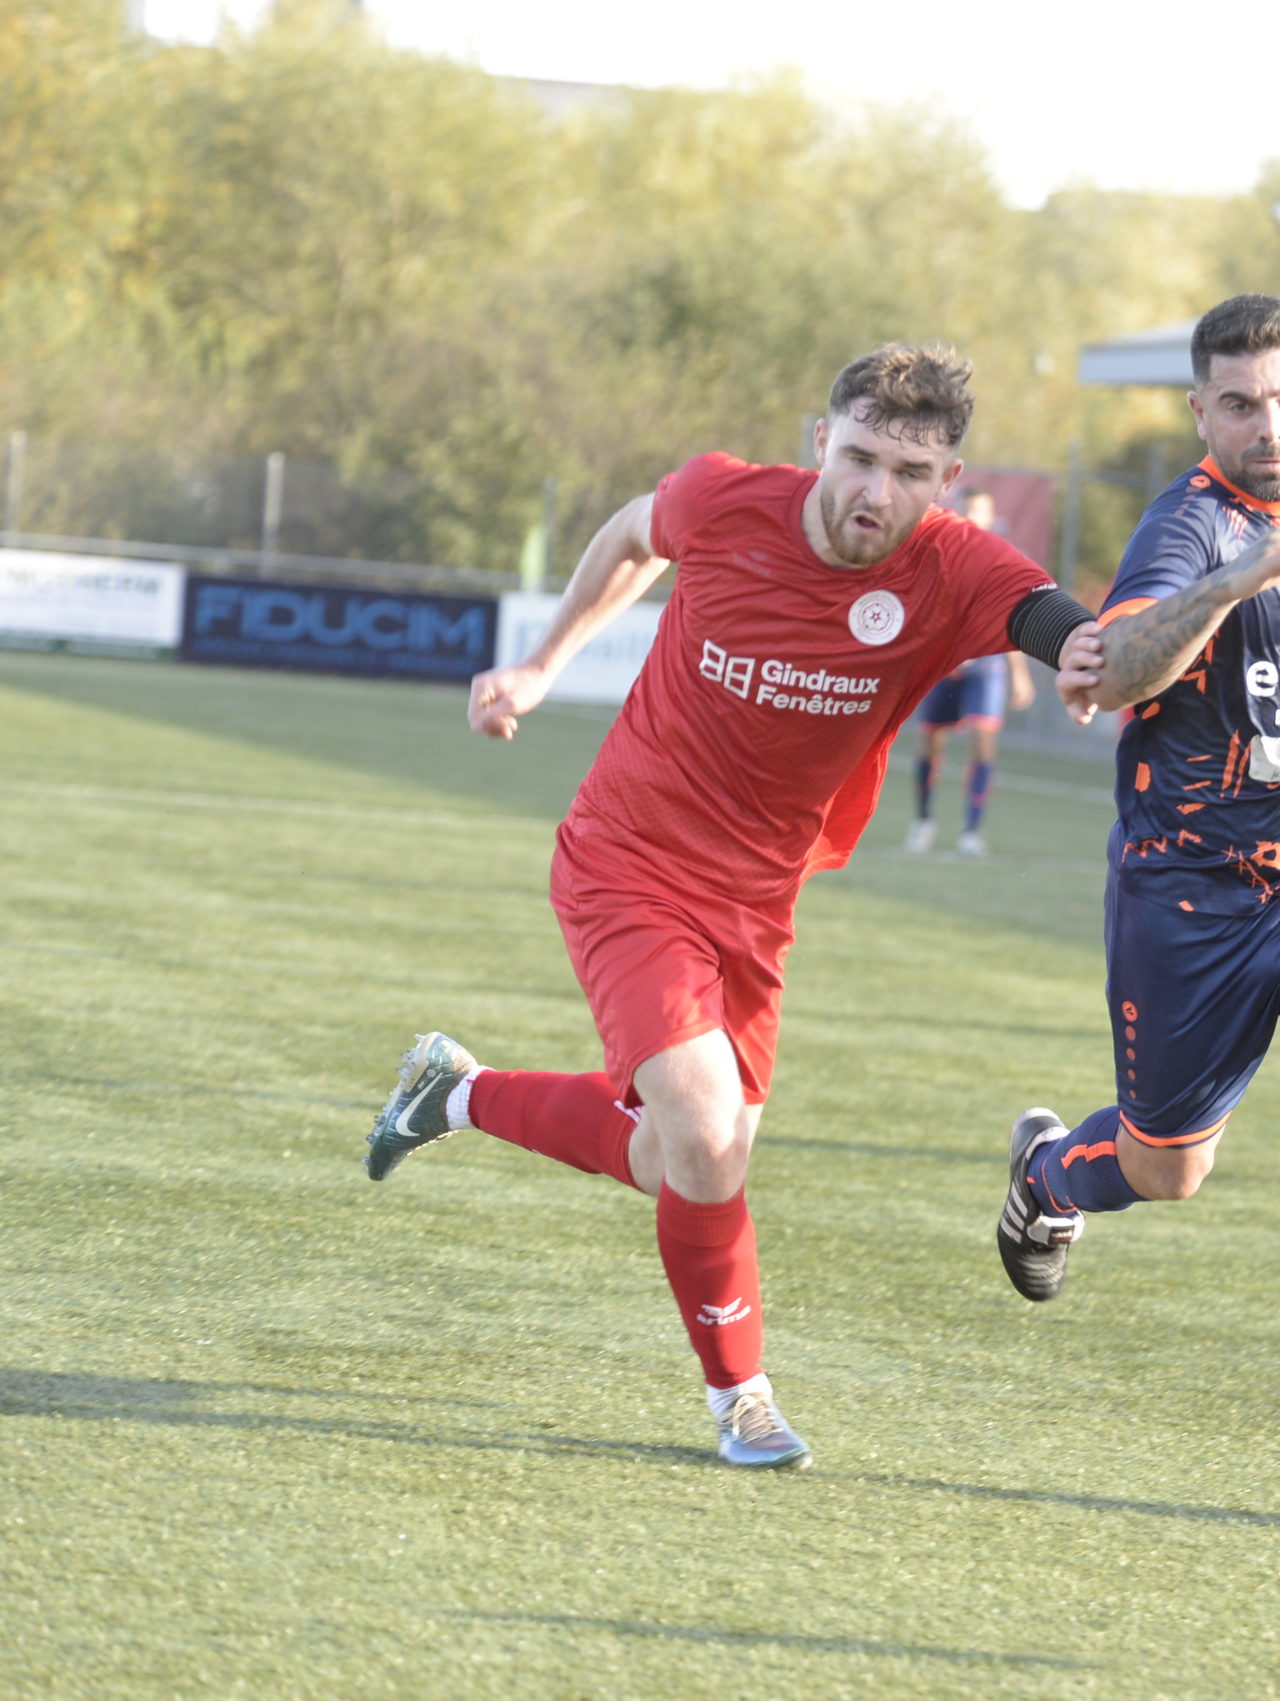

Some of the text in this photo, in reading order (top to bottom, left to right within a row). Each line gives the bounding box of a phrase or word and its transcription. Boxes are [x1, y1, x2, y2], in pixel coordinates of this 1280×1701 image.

[195, 583, 486, 653] FIDUCIM
[761, 659, 881, 694] Gindraux
[755, 683, 872, 715] Fenêtres
